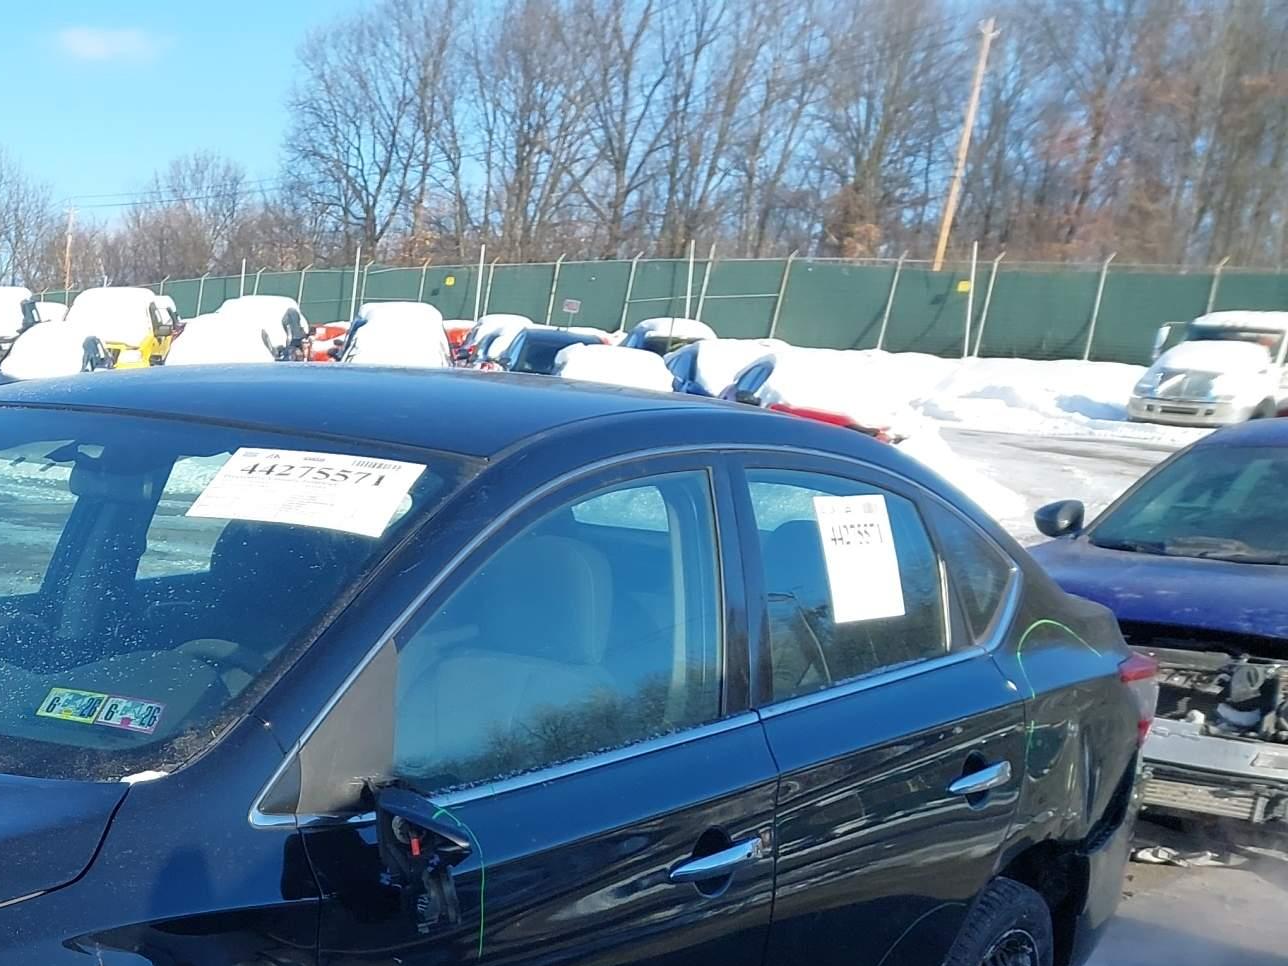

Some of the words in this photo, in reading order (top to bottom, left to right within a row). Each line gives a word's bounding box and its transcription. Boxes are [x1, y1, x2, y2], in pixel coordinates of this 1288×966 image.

[240, 462, 386, 486] 44275571
[79, 697, 102, 718] 26
[139, 705, 161, 728] 26
